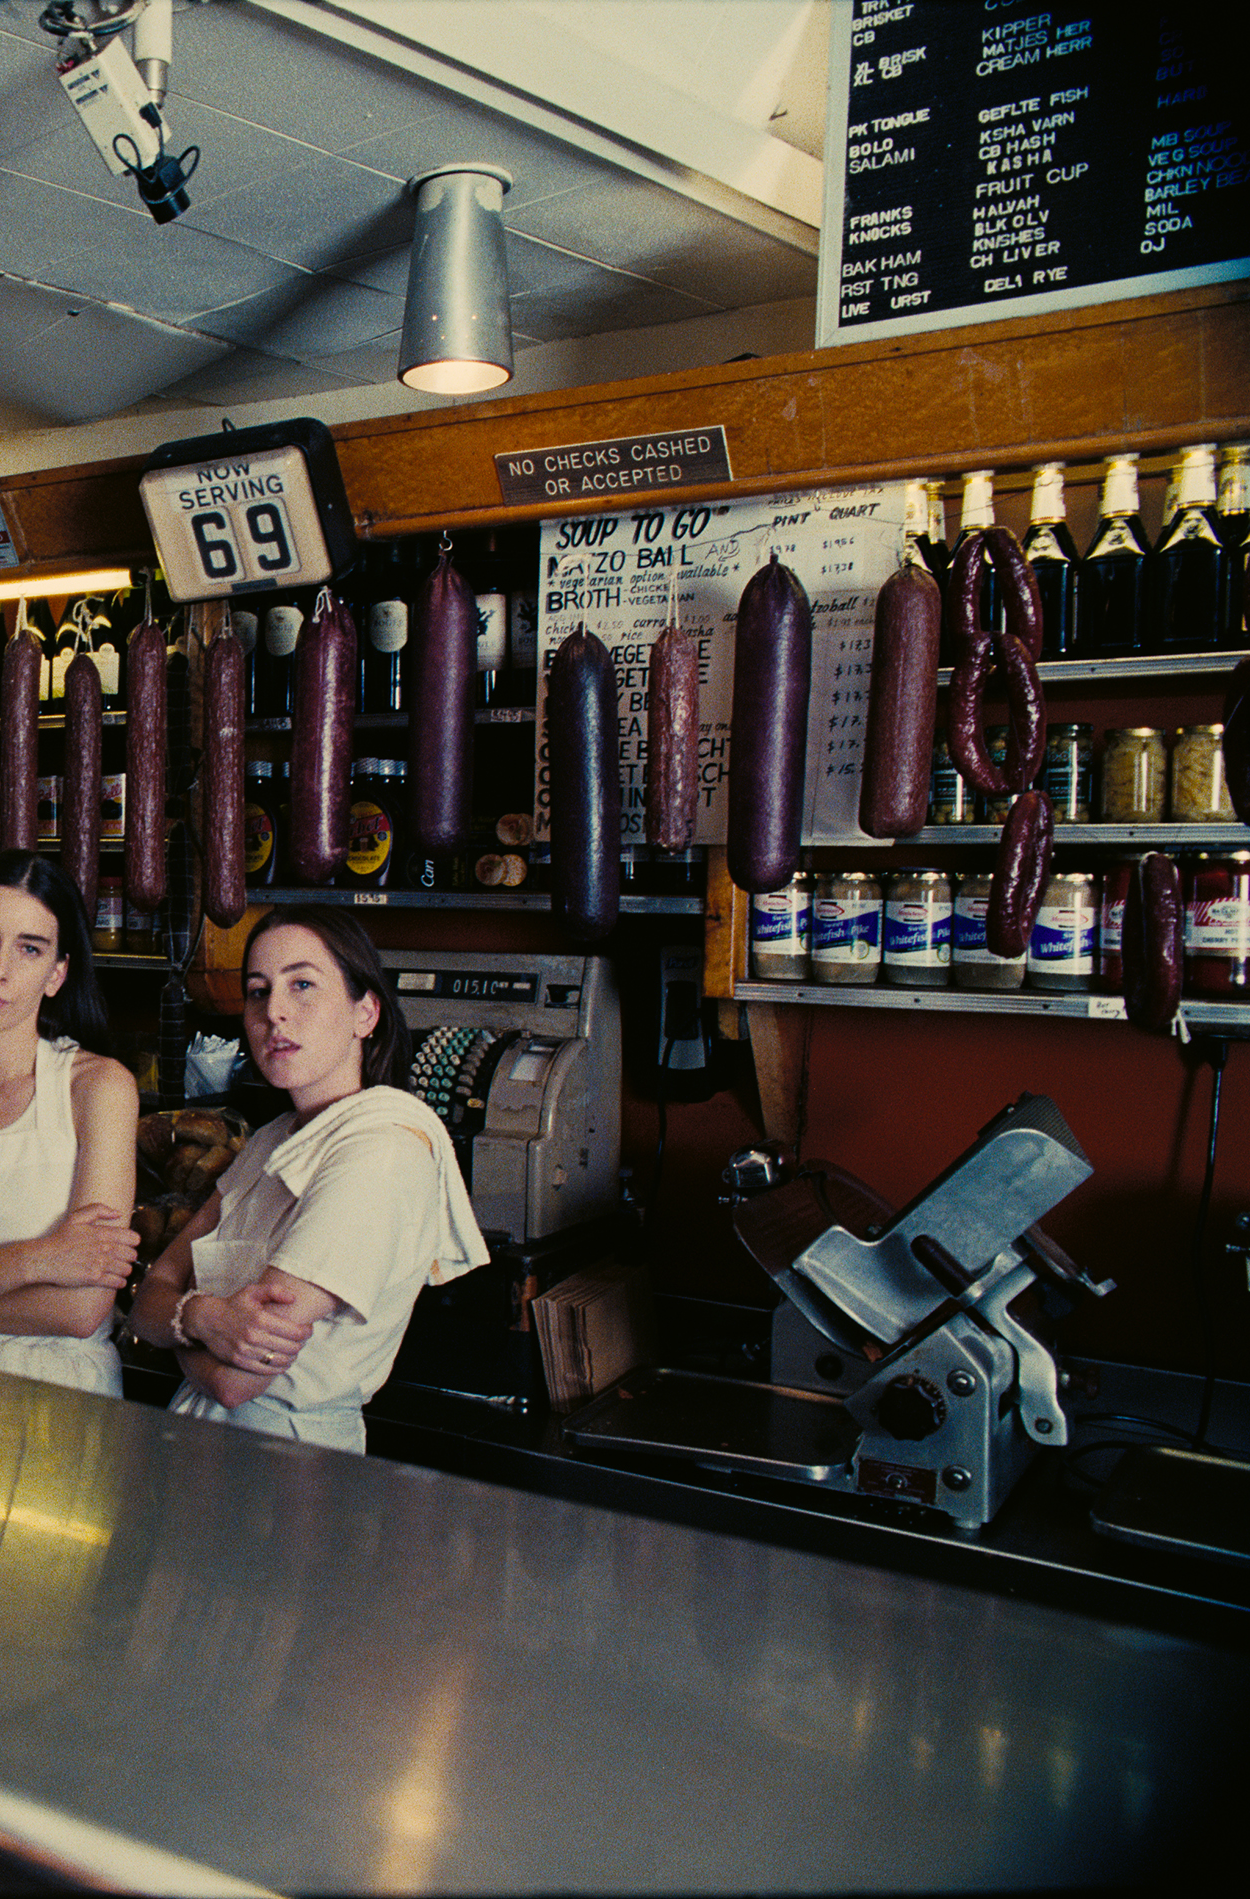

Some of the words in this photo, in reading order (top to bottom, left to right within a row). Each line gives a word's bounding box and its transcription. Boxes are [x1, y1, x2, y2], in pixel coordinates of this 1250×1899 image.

[852, 4, 914, 32] BRISKET
[982, 12, 1052, 44] KIPPER
[852, 30, 875, 46] CB
[982, 29, 1048, 59] MATJES
[1056, 18, 1092, 40] HER
[878, 46, 927, 70] BRISK
[976, 48, 1041, 77] CREAM
[1046, 34, 1093, 59] HERR
[882, 64, 902, 79] CB
[978, 97, 1041, 124] GEFLTE
[1050, 85, 1089, 107] FISH
[848, 122, 868, 138] PK
[870, 108, 930, 132] TONGUE
[980, 123, 1026, 144] KSHA
[1032, 110, 1075, 132] VARN
[1151, 131, 1180, 150] MB
[1184, 120, 1231, 143] SOUP
[979, 144, 1002, 160] CB
[1006, 132, 1056, 155] HASH
[1188, 136, 1238, 159] SOUP
[850, 147, 915, 174] SALAMI
[986, 148, 1052, 176] KASHA
[1146, 160, 1195, 185] CHKN
[976, 174, 1034, 199] FRUIT
[1046, 162, 1089, 184] CUP
[1144, 176, 1212, 203] BARLEY
[850, 206, 913, 230] FRANKS
[972, 194, 1040, 220] HALVAH
[1146, 201, 1181, 220] MIL
[849, 221, 912, 245] KNOCKS
[974, 218, 1008, 237] BLK
[1012, 209, 1050, 228] OLV
[1144, 214, 1194, 236] SODA
[972, 227, 1045, 252] KNISHES
[1140, 236, 1167, 254] OJ
[842, 258, 878, 278] BAK
[881, 250, 922, 270] HAM
[970, 252, 994, 268] CH
[1002, 240, 1060, 263] LIVER
[841, 280, 874, 298] RST
[880, 272, 919, 291] TNG
[1033, 266, 1068, 284] RYE
[890, 290, 932, 310] URST
[508, 459, 535, 476] NO
[544, 448, 620, 472] CHECKS
[630, 436, 712, 462] CASHED
[197, 463, 250, 484] NOW
[544, 478, 571, 496] OR
[581, 464, 682, 492] ACCEPTED
[179, 474, 284, 510] SERVING
[556, 517, 619, 550] SOUP
[631, 512, 665, 544] TO
[672, 506, 712, 541] GO
[773, 511, 811, 527] PINT
[829, 503, 881, 520] QUART
[191, 502, 292, 579] 69
[630, 570, 665, 589] option
[546, 587, 621, 614] BROTH
[620, 629, 643, 642] rice
